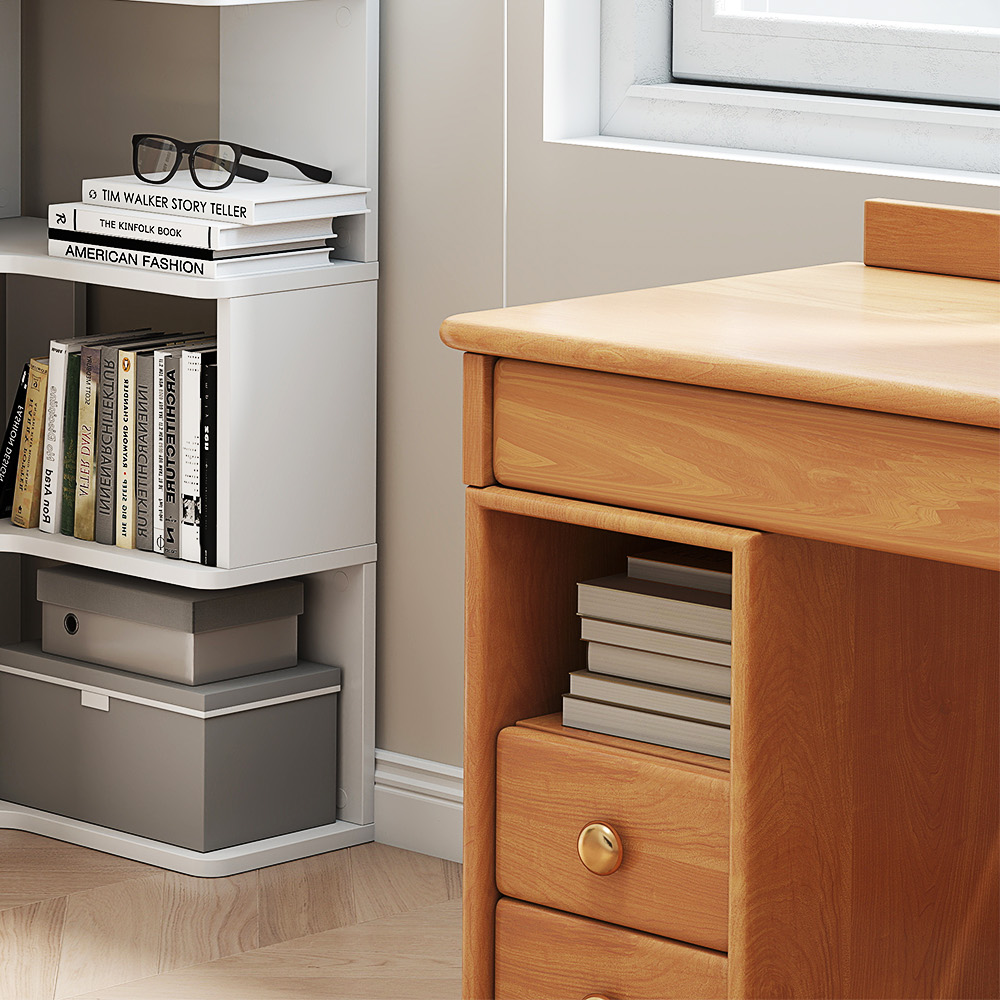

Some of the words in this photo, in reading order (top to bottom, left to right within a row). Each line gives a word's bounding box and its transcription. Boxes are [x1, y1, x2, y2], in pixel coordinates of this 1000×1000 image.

[102, 189, 120, 202] TIM
[124, 192, 168, 208] WALKER
[172, 198, 206, 213] STORY
[210, 203, 247, 218] TELLER
[100, 219, 116, 228] THE
[118, 222, 154, 234] KINFOLK
[158, 226, 182, 237] BOOK
[65, 245, 138, 266] AMERICAN
[142, 256, 204, 274] FASHION
